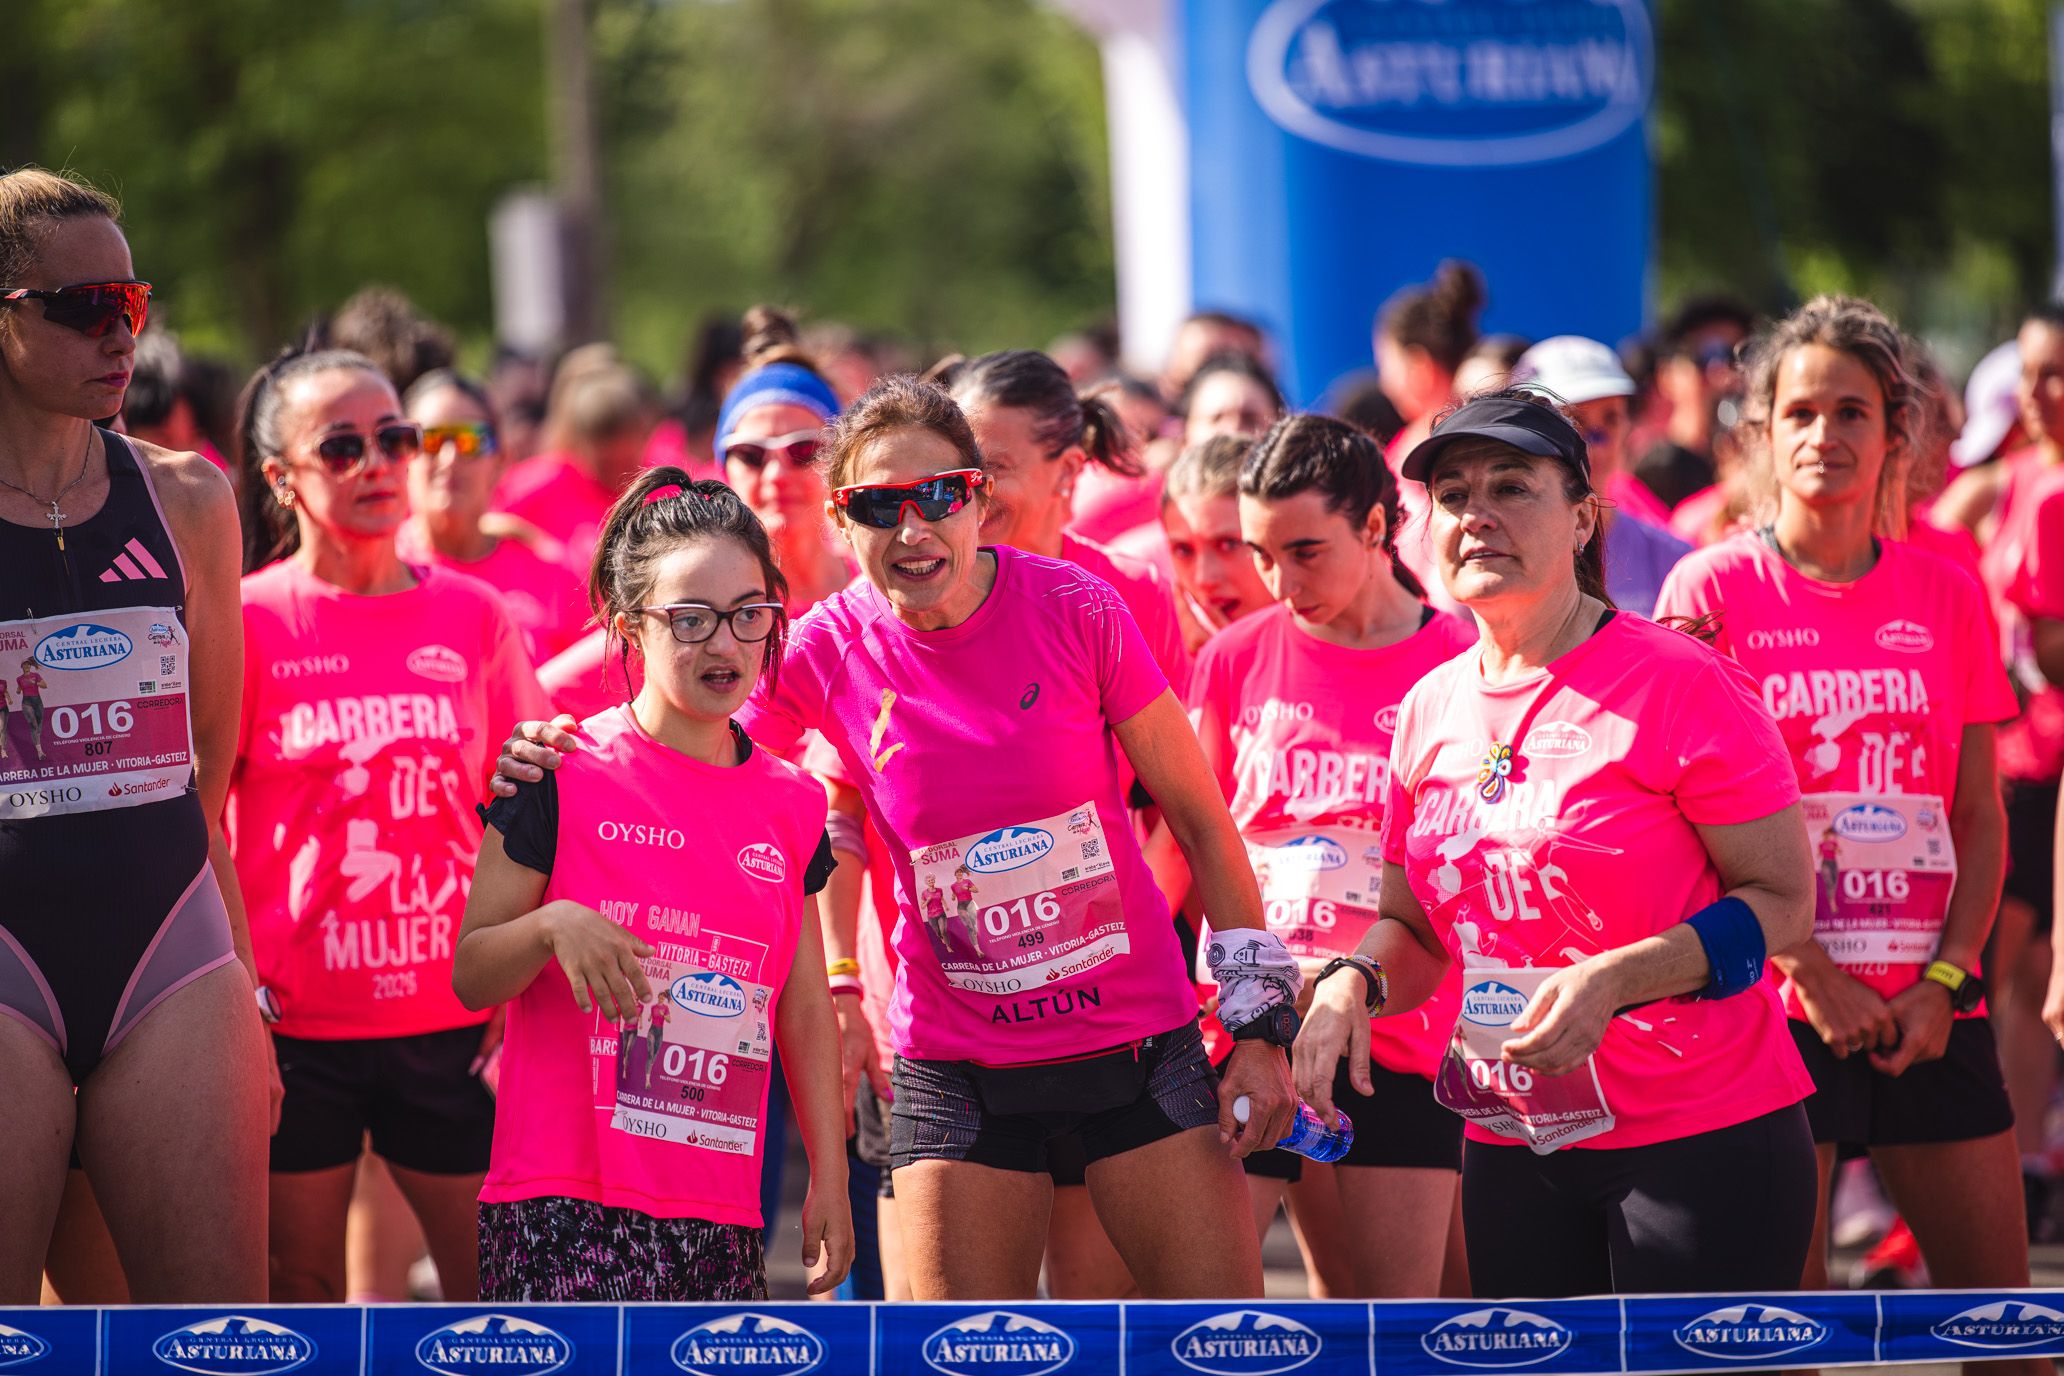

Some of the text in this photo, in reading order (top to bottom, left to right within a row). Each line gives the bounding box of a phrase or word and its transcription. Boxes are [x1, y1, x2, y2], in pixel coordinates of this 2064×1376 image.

[56, 639, 87, 647] CENTRAL
[1747, 628, 1820, 650] OYSHO
[43, 642, 127, 662] ASTURIANA
[271, 653, 349, 679] OYSHO
[1762, 668, 1930, 721] CARRERA
[51, 701, 134, 739] 016
[1244, 701, 1314, 725] OYSHO
[84, 741, 113, 756] 807
[1528, 735, 1586, 751] ASTURIANA
[40, 767, 54, 777] DE
[56, 765, 70, 775] LA
[73, 761, 109, 774] MUJER
[116, 751, 187, 769] VITORIA-GASTEIZ
[1858, 732, 1910, 796] DE
[9, 787, 82, 808] OYSHO
[124, 778, 171, 795] Santander
[389, 756, 443, 820] DE
[597, 820, 685, 850] OYSHO
[928, 841, 958, 853] DORSAL
[983, 840, 1013, 853] CENTRAL
[921, 847, 961, 865] SUMA
[973, 839, 1049, 868] ASTURIANA
[1061, 874, 1116, 896] CORREDORA
[1483, 850, 1542, 922] DE
[1843, 869, 1910, 900] 016
[600, 900, 701, 938] HOY GANAN
[984, 891, 1061, 936] 016
[1266, 900, 1337, 929] 016
[323, 914, 451, 971] MUJER
[941, 921, 1126, 972] CARRERA DE LA MUJER VITORIA-GASTEIZ
[1017, 931, 1045, 949] 499
[1822, 939, 1868, 953] YSHO
[641, 964, 670, 981] UMA
[646, 956, 673, 970] DORSAL
[659, 943, 700, 966] VITORIA
[707, 953, 750, 977] GASTEIZ
[1061, 945, 1116, 977] Santander
[676, 982, 743, 1011] ASTURIANA
[963, 978, 1022, 994] OYSHO
[992, 986, 1101, 1024] ALTÚN
[1463, 998, 1524, 1016] ASTURIANA
[663, 1044, 729, 1085] 016
[1470, 1060, 1533, 1092] 016
[680, 1085, 705, 1102] 500
[642, 1099, 653, 1109] DE
[654, 1101, 665, 1111] LA
[666, 1103, 696, 1117] MUJER
[701, 1109, 757, 1129] VITORIA-GASTEIZ
[623, 1116, 667, 1138] OYSHO
[1536, 1118, 1596, 1146] Santander
[699, 1134, 744, 1152] Santander
[1183, 1336, 1310, 1359] ASTURIANA
[1433, 1331, 1562, 1352] ASTURIANA
[1684, 1327, 1814, 1344] ASTURIANA
[164, 1338, 298, 1360] ASTURIANA
[427, 1339, 558, 1364] ASTURIANA
[681, 1339, 812, 1365] ASTURIANA
[932, 1337, 1062, 1363] ASTURIANA
